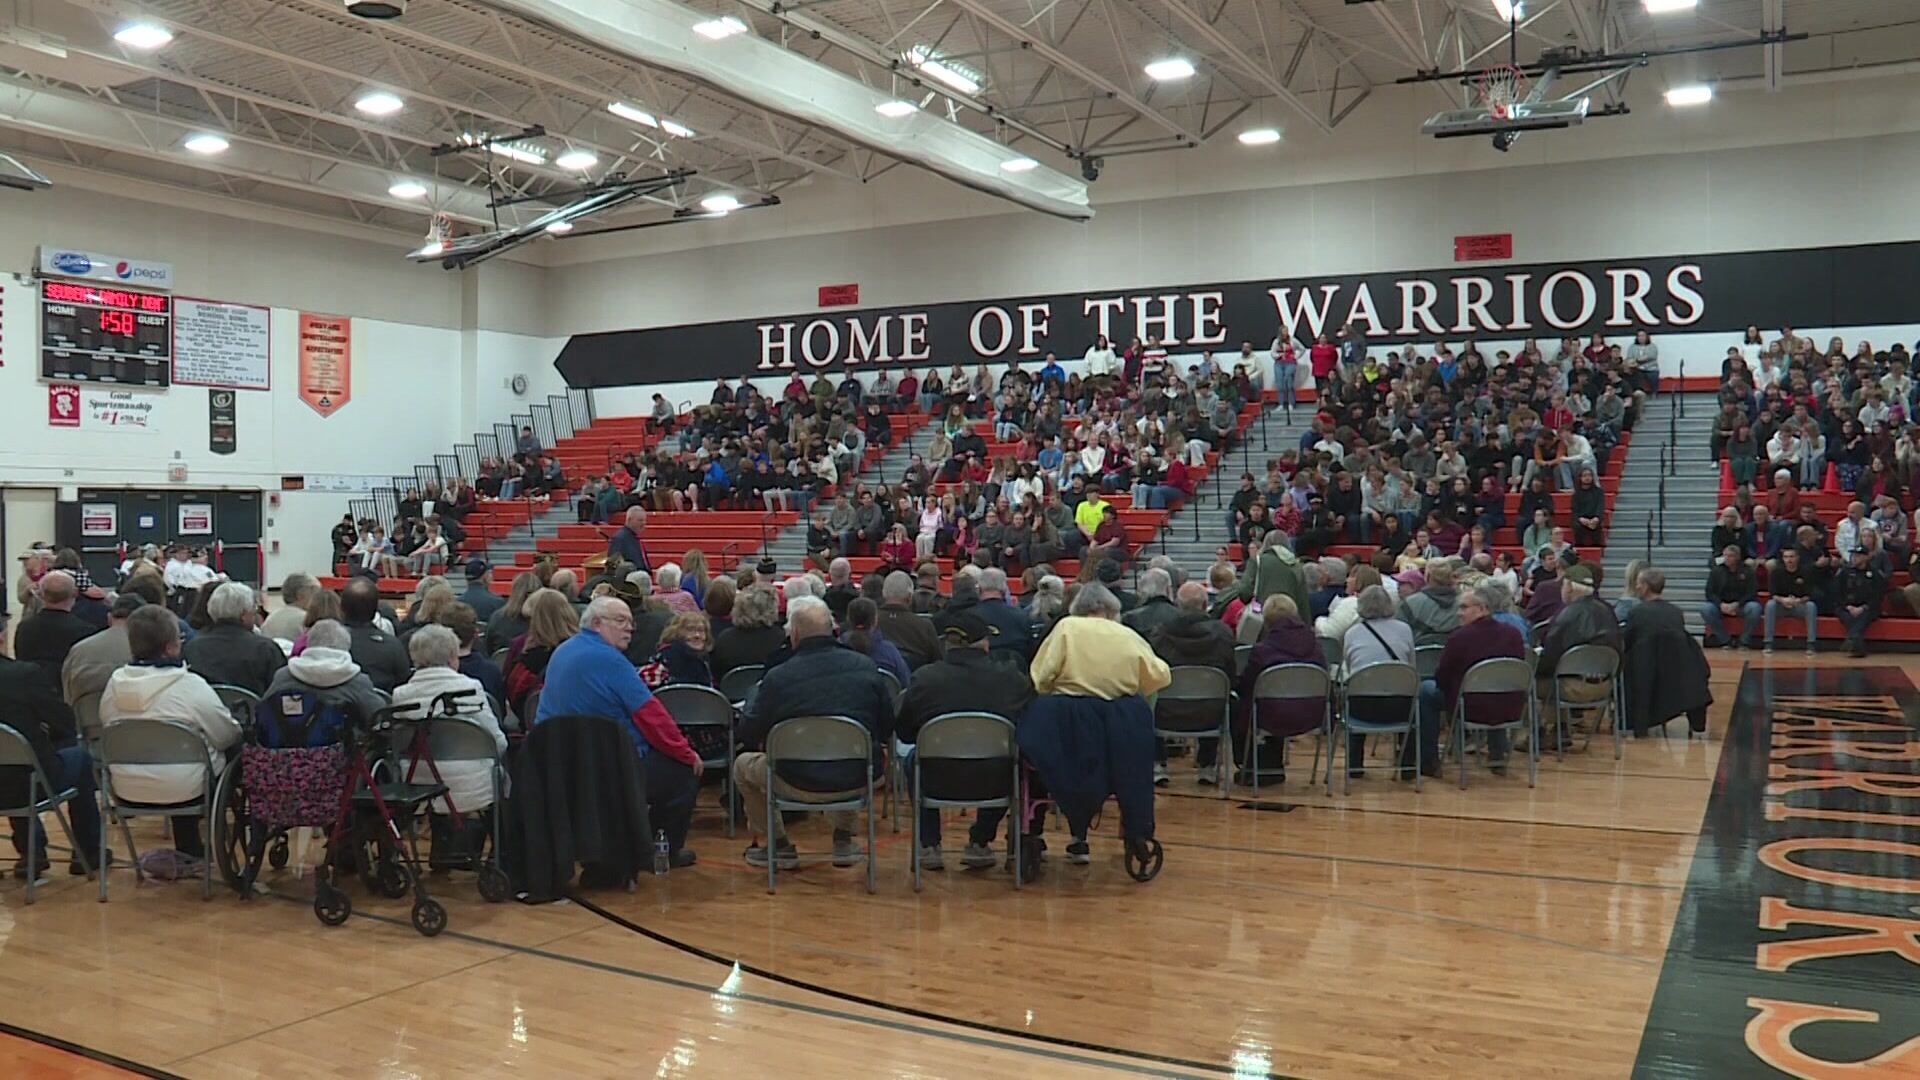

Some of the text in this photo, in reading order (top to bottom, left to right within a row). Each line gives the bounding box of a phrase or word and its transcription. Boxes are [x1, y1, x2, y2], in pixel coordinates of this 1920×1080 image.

[133, 268, 166, 280] pepsi
[47, 305, 165, 326] HOME GUEST
[101, 310, 134, 334] 1:58
[757, 264, 1706, 370] HOME OF THE WARRIORS
[110, 391, 132, 400] Good
[89, 399, 152, 413] Sportsmanship
[101, 411, 118, 425] #1
